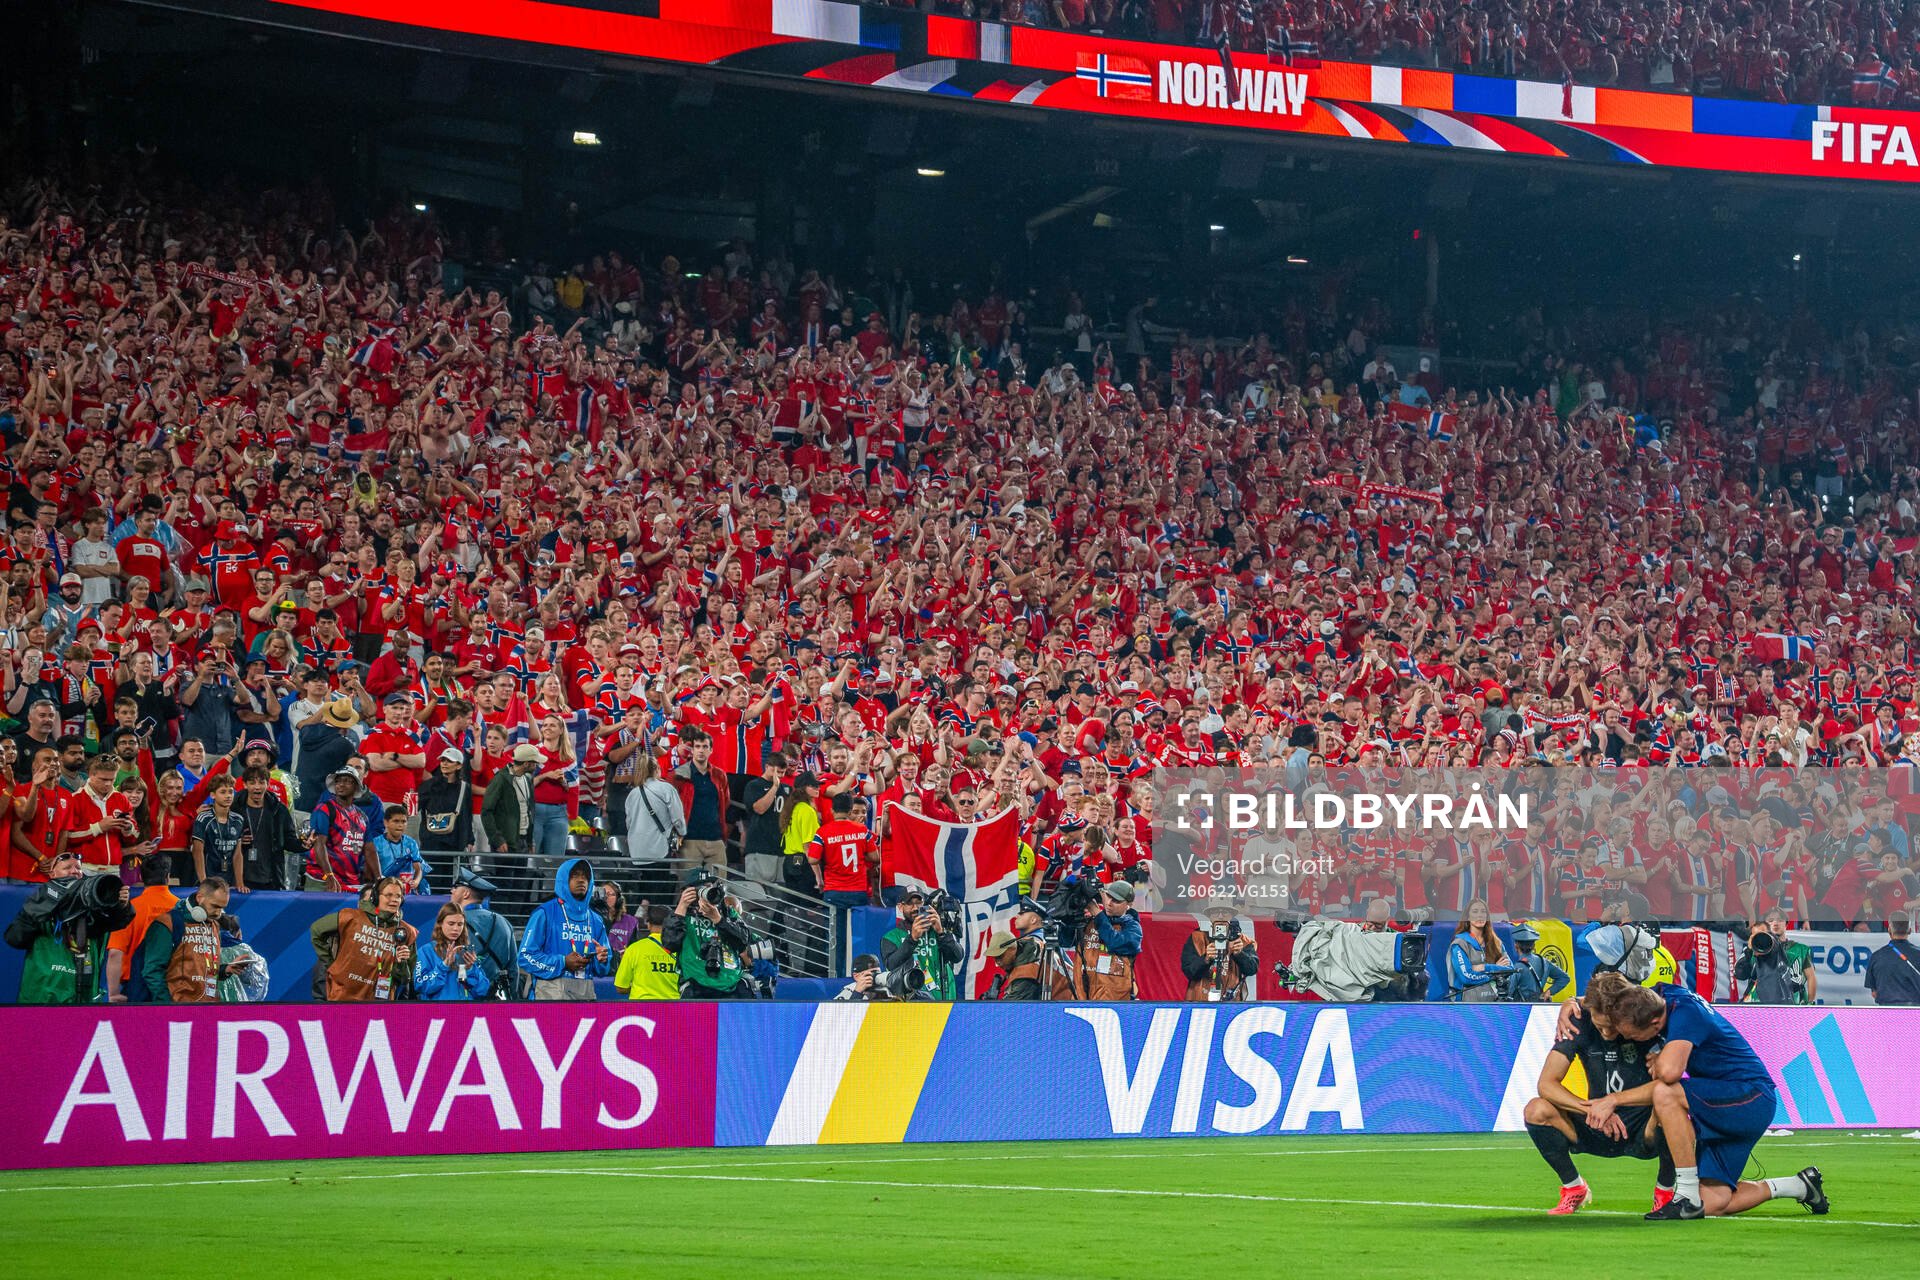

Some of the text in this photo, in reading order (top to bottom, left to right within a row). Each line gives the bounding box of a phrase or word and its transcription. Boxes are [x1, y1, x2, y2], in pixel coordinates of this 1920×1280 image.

[1159, 60, 1308, 116] NORWAY
[1812, 120, 1919, 167] FIFA
[841, 843, 858, 872] 9
[362, 925, 393, 942] MEDIA
[1697, 933, 1709, 975] ELSKER
[651, 962, 676, 973] 181
[44, 1016, 659, 1144] AIRWAYS
[1064, 1006, 1365, 1133] VISA
